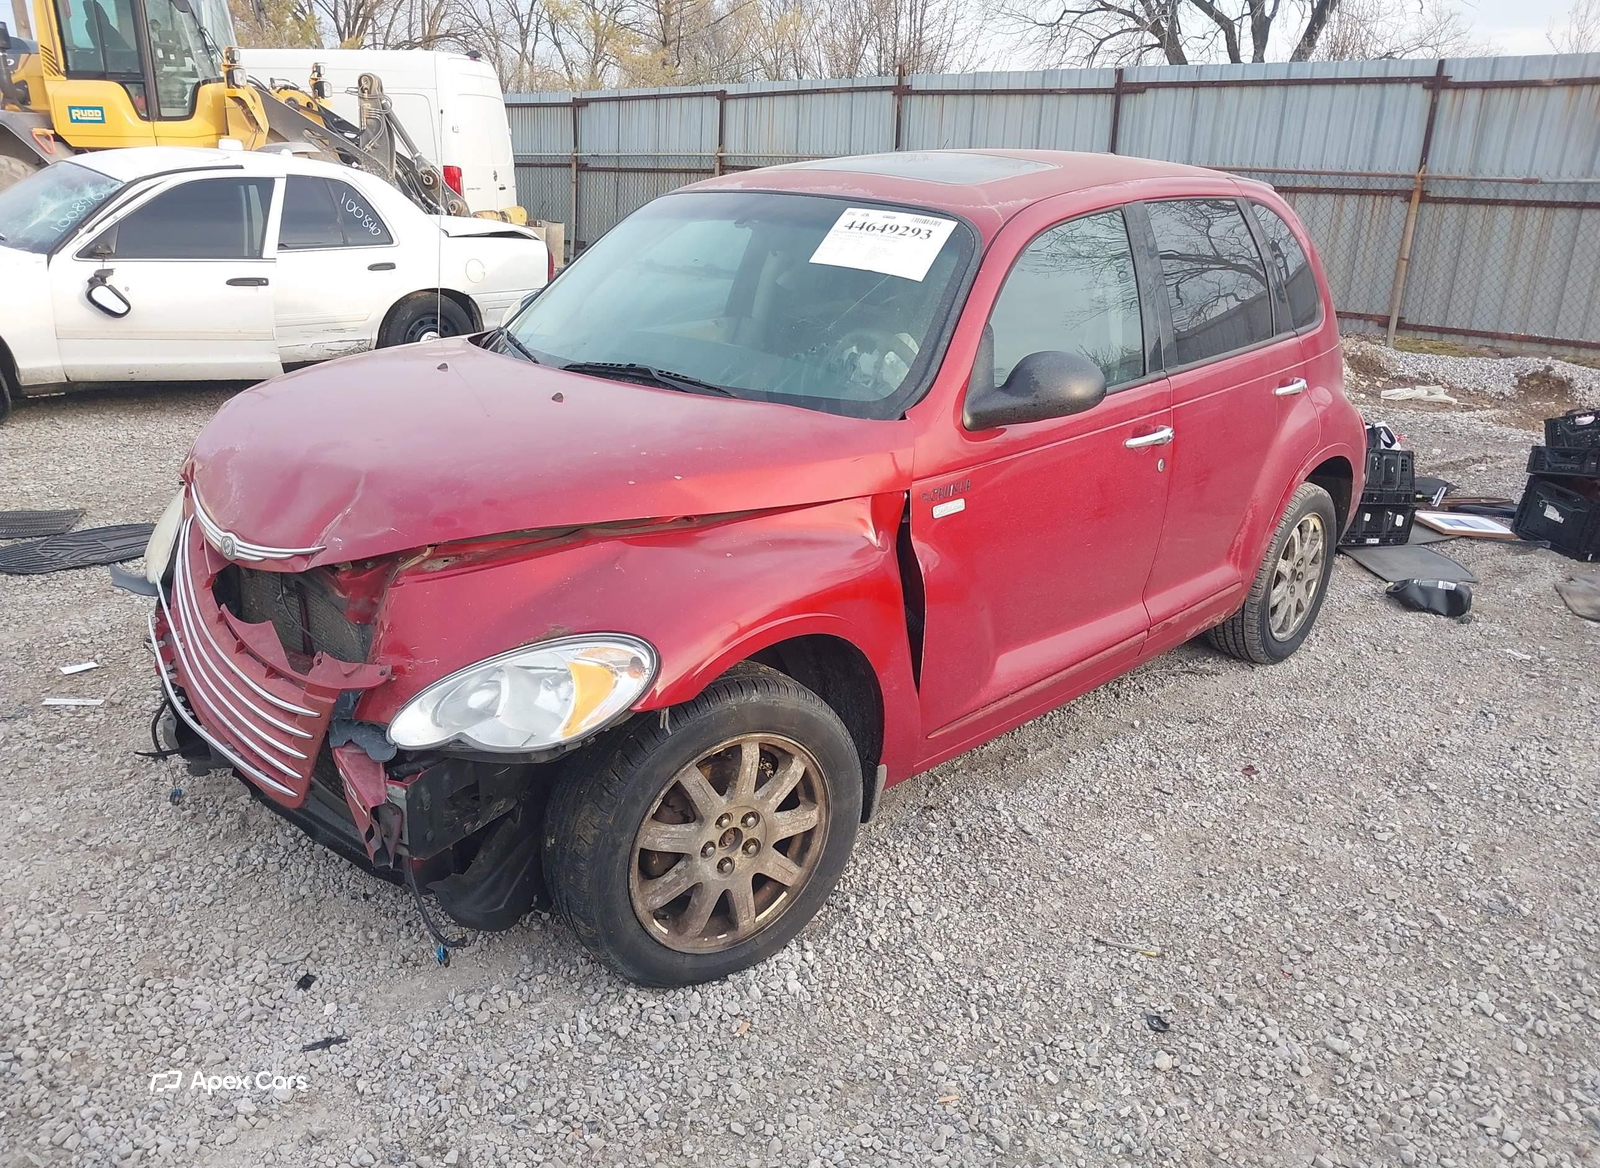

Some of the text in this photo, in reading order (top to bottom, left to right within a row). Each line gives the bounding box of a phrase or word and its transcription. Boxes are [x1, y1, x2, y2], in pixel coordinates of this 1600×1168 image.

[71, 109, 102, 120] RUDD
[340, 191, 381, 236] 100840
[844, 219, 933, 241] 44649293
